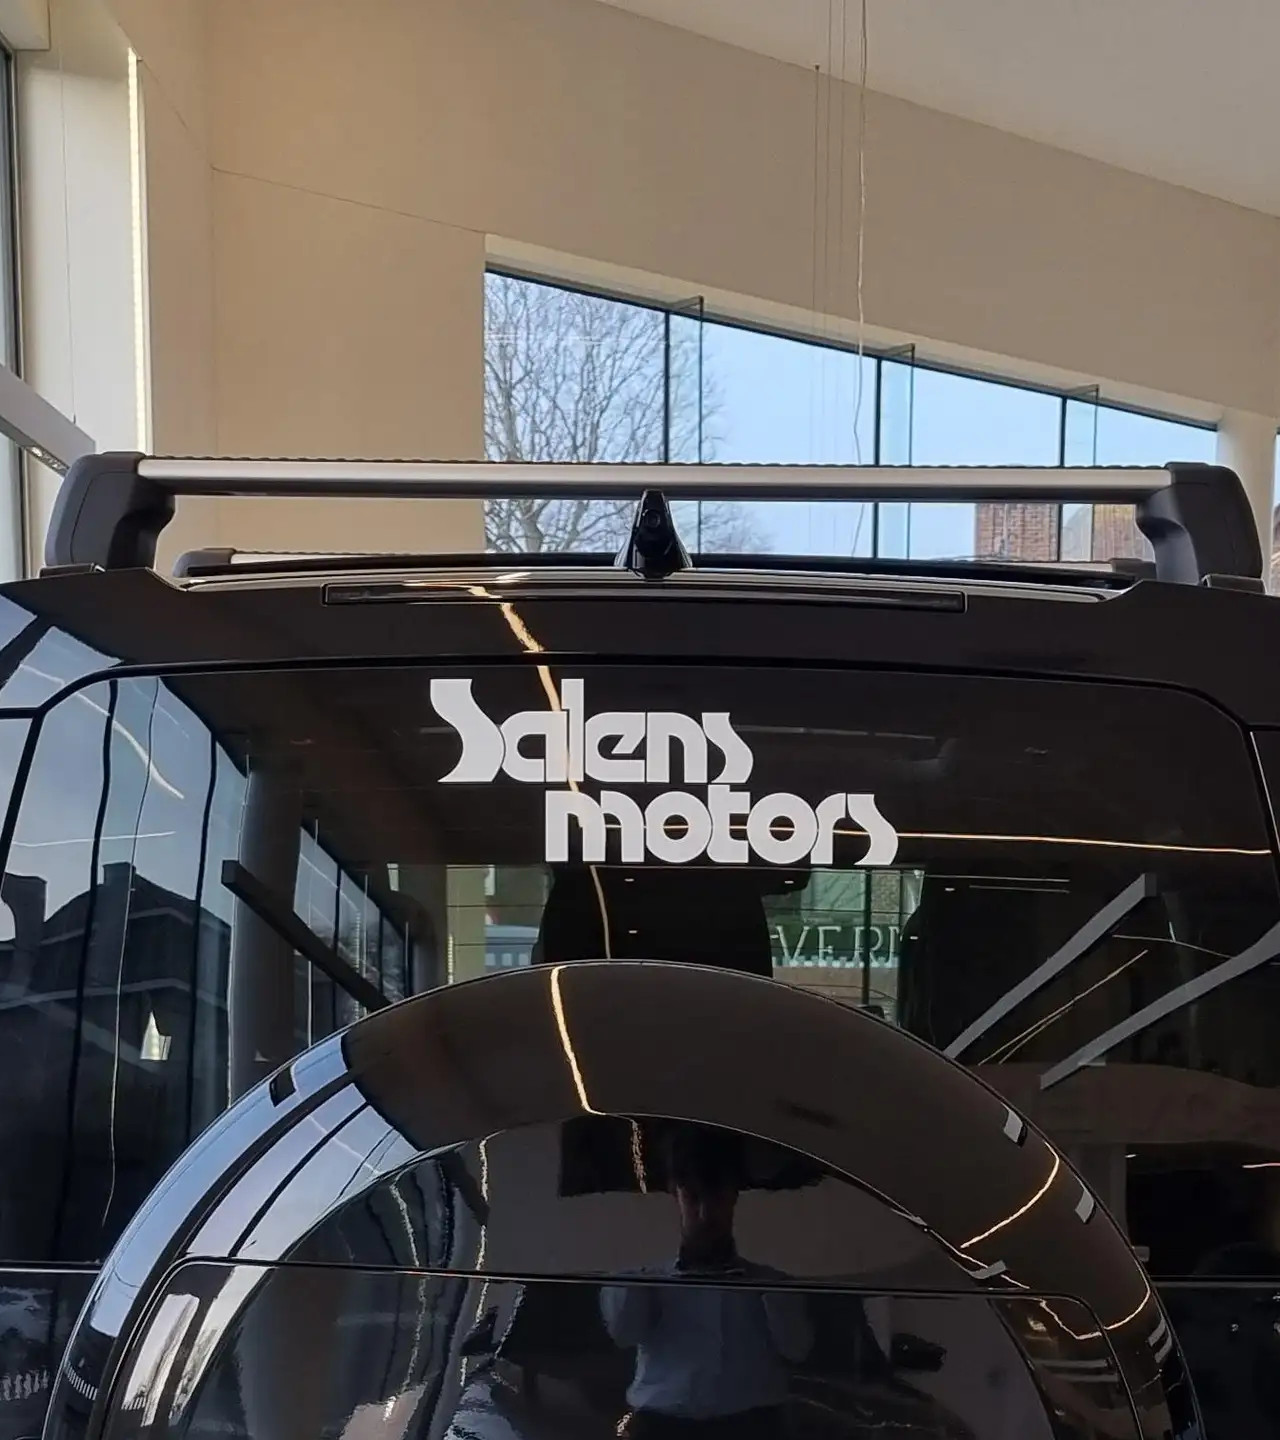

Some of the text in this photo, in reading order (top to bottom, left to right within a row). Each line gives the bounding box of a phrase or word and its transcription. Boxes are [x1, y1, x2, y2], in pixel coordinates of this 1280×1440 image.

[430, 679, 753, 783] Salens
[545, 784, 898, 866] motors
[776, 925, 902, 968] VER
